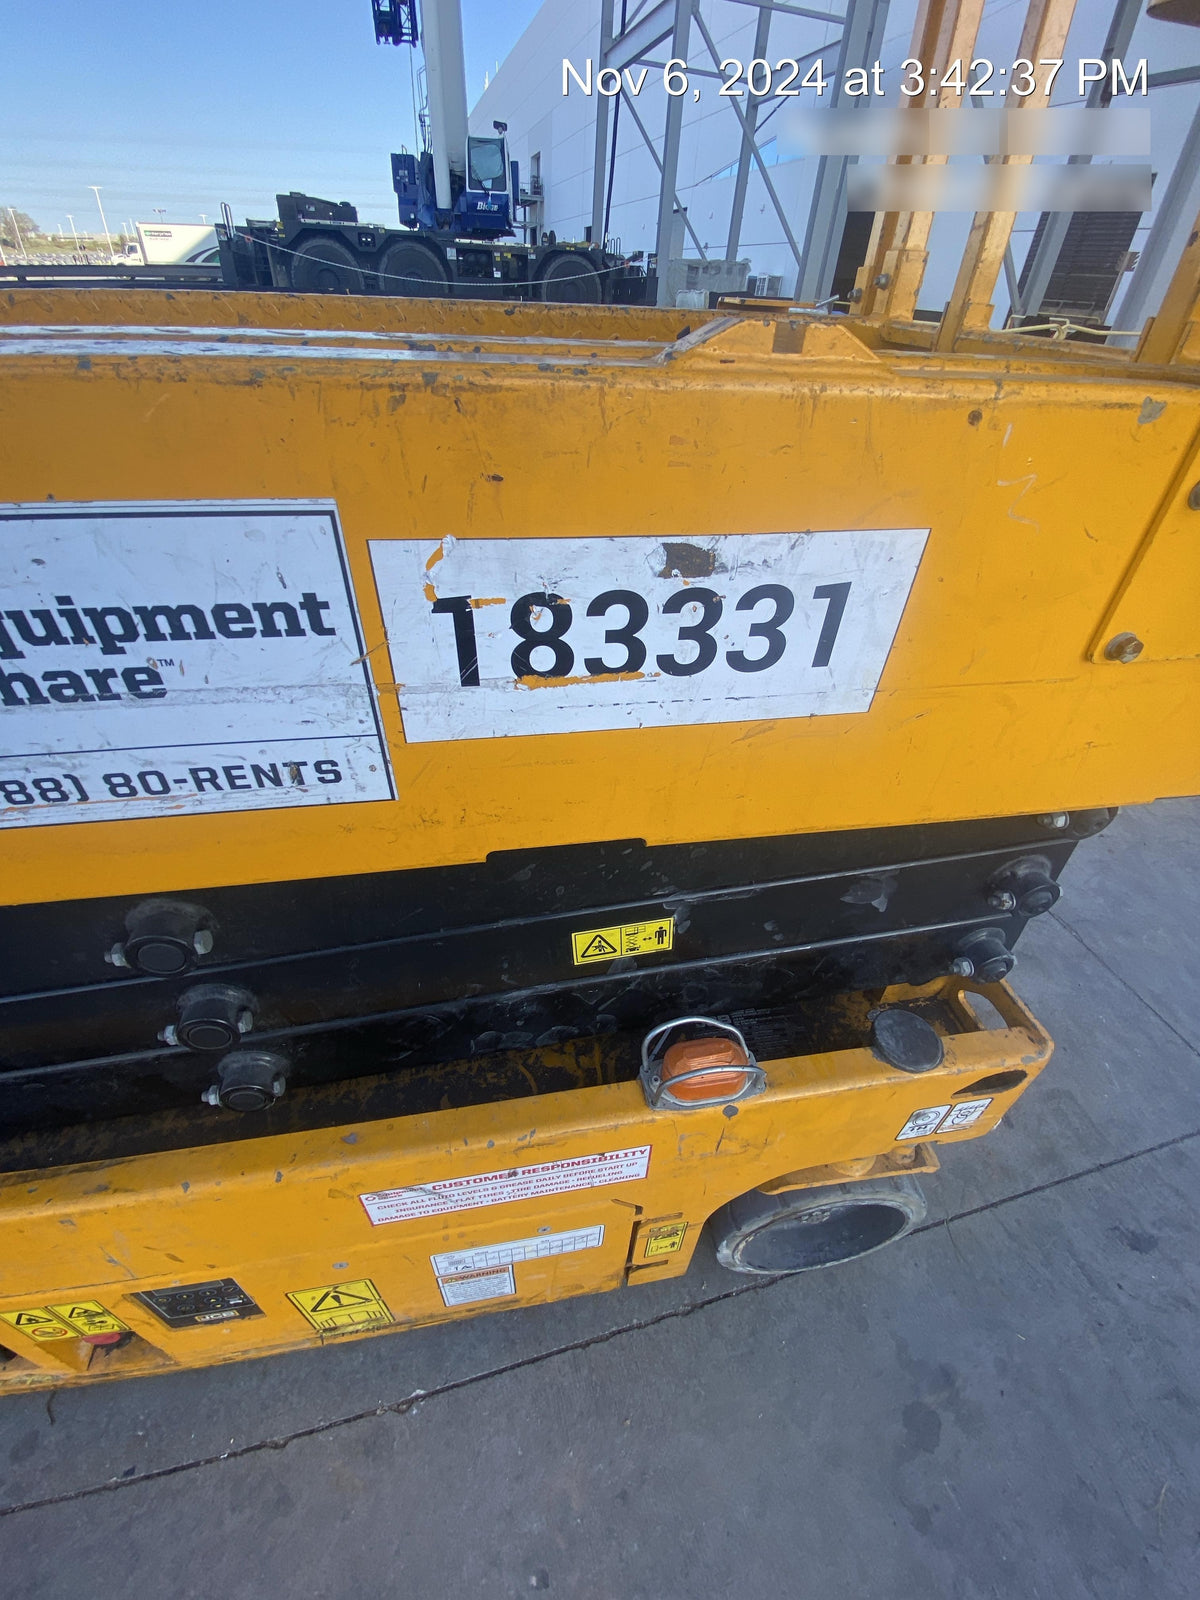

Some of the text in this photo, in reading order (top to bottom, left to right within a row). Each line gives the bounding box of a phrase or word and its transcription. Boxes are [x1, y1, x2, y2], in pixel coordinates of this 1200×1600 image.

[431, 581, 852, 687] 183331
[102, 758, 343, 799] 80-RENTS
[376, 1201, 407, 1210] CHECK
[456, 1187, 489, 1196] LEVELS
[499, 1179, 533, 1189] GREASE
[535, 1174, 561, 1183] DAILY
[563, 1168, 596, 1178] BEFORE
[597, 1163, 624, 1172] START
[430, 1148, 647, 1191] CUSTOMER RESPONSIBILITY
[377, 1212, 416, 1222] DAMAGE
[431, 1200, 484, 1213] EQUIPMENT
[490, 1192, 528, 1202] BATTERY
[530, 1181, 591, 1195] MAINTENANCE
[598, 1172, 640, 1183] CLEANING
[394, 1200, 448, 1213] INSURANCE
[454, 1195, 475, 1203] FLAT
[478, 1190, 504, 1198] TIRES
[533, 1179, 569, 1189] DAMAGE
